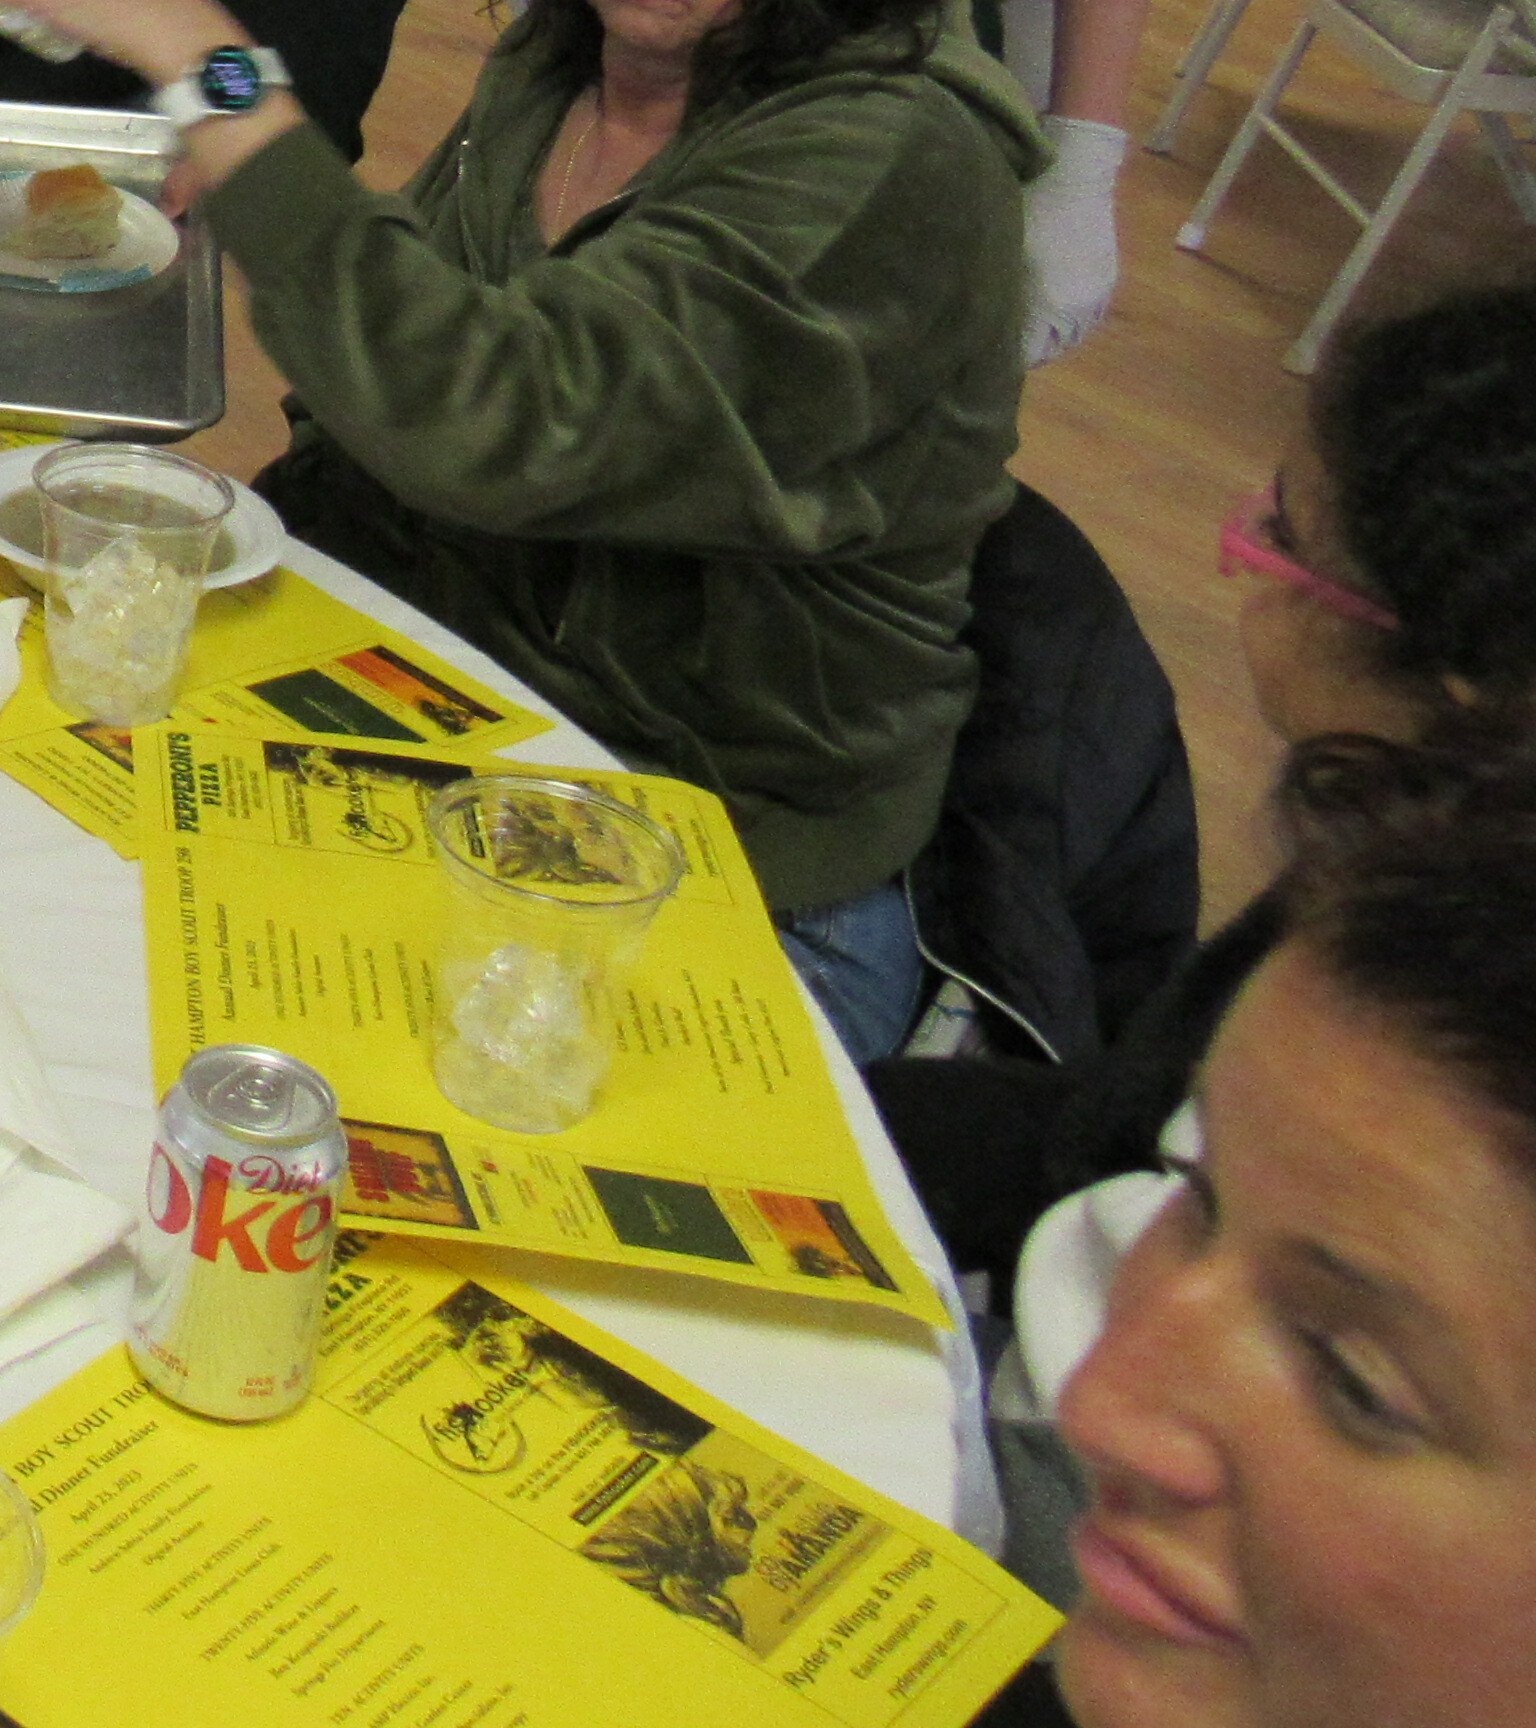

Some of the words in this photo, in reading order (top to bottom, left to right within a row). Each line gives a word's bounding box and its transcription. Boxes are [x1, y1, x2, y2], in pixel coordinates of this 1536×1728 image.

[167, 732, 198, 832] PEPPERONI'S
[199, 763, 221, 806] PIZZA
[175, 846, 192, 863] 298
[176, 865, 194, 903] TROOP
[180, 907, 198, 945] SCOUT
[183, 951, 200, 975] BOY
[186, 979, 205, 1044] HAMPTON
[238, 1155, 321, 1194] Diet
[13, 1445, 54, 1476] BOY
[53, 1407, 112, 1445] SCOUT
[38, 1467, 91, 1504] Dinner
[86, 1420, 158, 1468] Fundraiser
[70, 1499, 99, 1522] April
[881, 1547, 932, 1586] Things
[871, 1581, 893, 1601] &
[830, 1598, 881, 1638] Wings
[849, 1654, 880, 1679] East
[916, 1596, 935, 1612] NY
[782, 1637, 842, 1687] Ryder's
